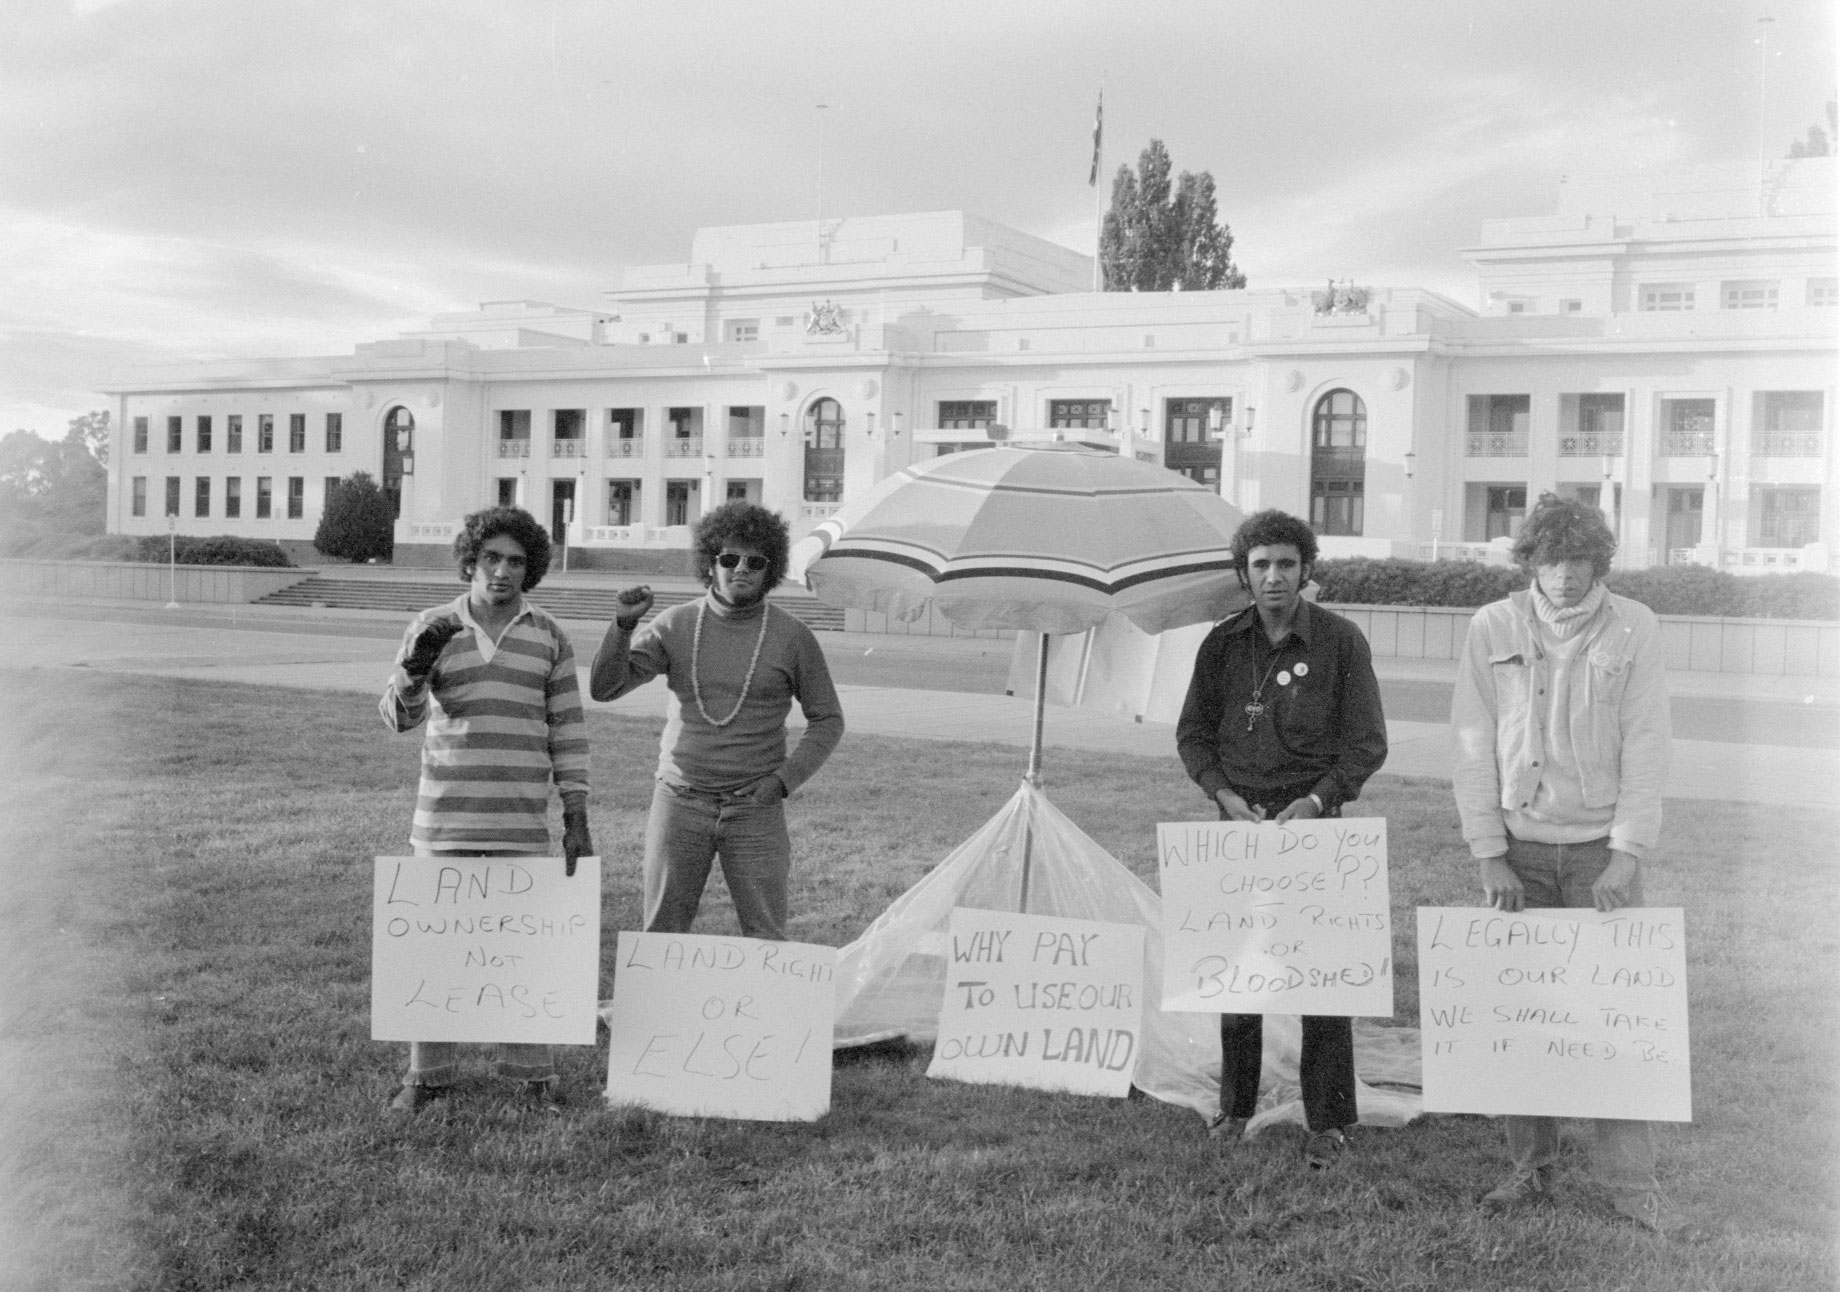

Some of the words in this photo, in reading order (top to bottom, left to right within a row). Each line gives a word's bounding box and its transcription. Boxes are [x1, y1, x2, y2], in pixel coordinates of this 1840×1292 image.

[1162, 829, 1259, 867] WHICH
[1277, 827, 1318, 854] DO
[1334, 827, 1380, 863] YOU
[388, 862, 533, 905] LAND
[388, 914, 585, 937] OWNERSHIP
[1179, 902, 1284, 932] LAND
[1300, 904, 1385, 930] RIGHTS
[954, 930, 1012, 963] WHY
[1033, 931, 1100, 966] PAY
[1431, 915, 1580, 963] LEGALLY
[1602, 918, 1674, 950] THIS
[465, 946, 523, 967] NOT
[627, 938, 745, 970] LAND
[758, 943, 833, 982] RIGHT
[1434, 967, 1464, 988] IS
[1499, 967, 1567, 985] OUR
[1591, 965, 1675, 987] LAND
[405, 979, 564, 1018] LEASE
[702, 995, 759, 1020] OR
[957, 981, 995, 1010] TO
[1431, 1005, 1473, 1028] WE
[1493, 1006, 1579, 1024] SHALL
[1600, 1007, 1667, 1031] TAKE
[941, 1031, 1028, 1060] OWN
[1042, 1027, 1134, 1071] LAND
[1435, 1041, 1460, 1055] IT
[1493, 1038, 1515, 1052] IF
[1548, 1037, 1616, 1060] NEED
